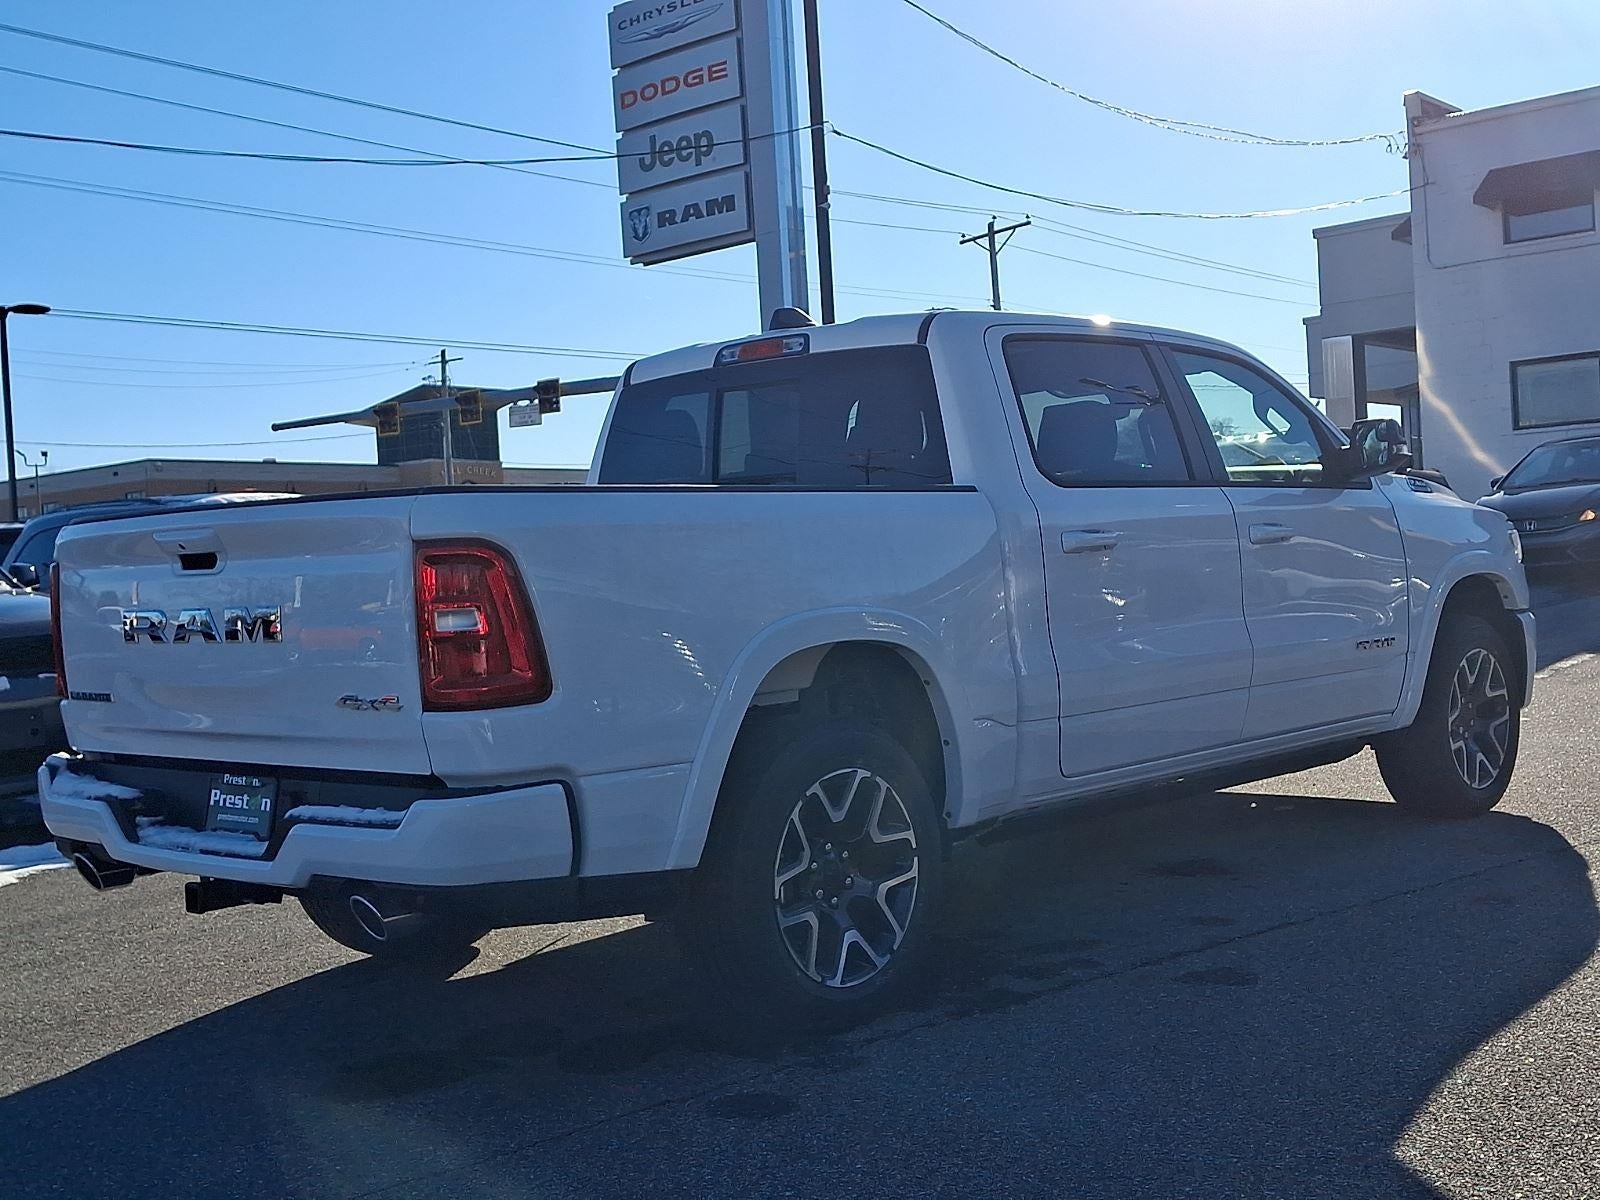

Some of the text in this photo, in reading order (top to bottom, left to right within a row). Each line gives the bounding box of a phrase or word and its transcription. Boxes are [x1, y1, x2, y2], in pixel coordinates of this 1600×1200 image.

[620, 60, 728, 110] DODGE
[639, 129, 714, 173] Jeep
[656, 194, 736, 228] RAM
[122, 606, 283, 644] RAM
[209, 789, 272, 812] Preston
